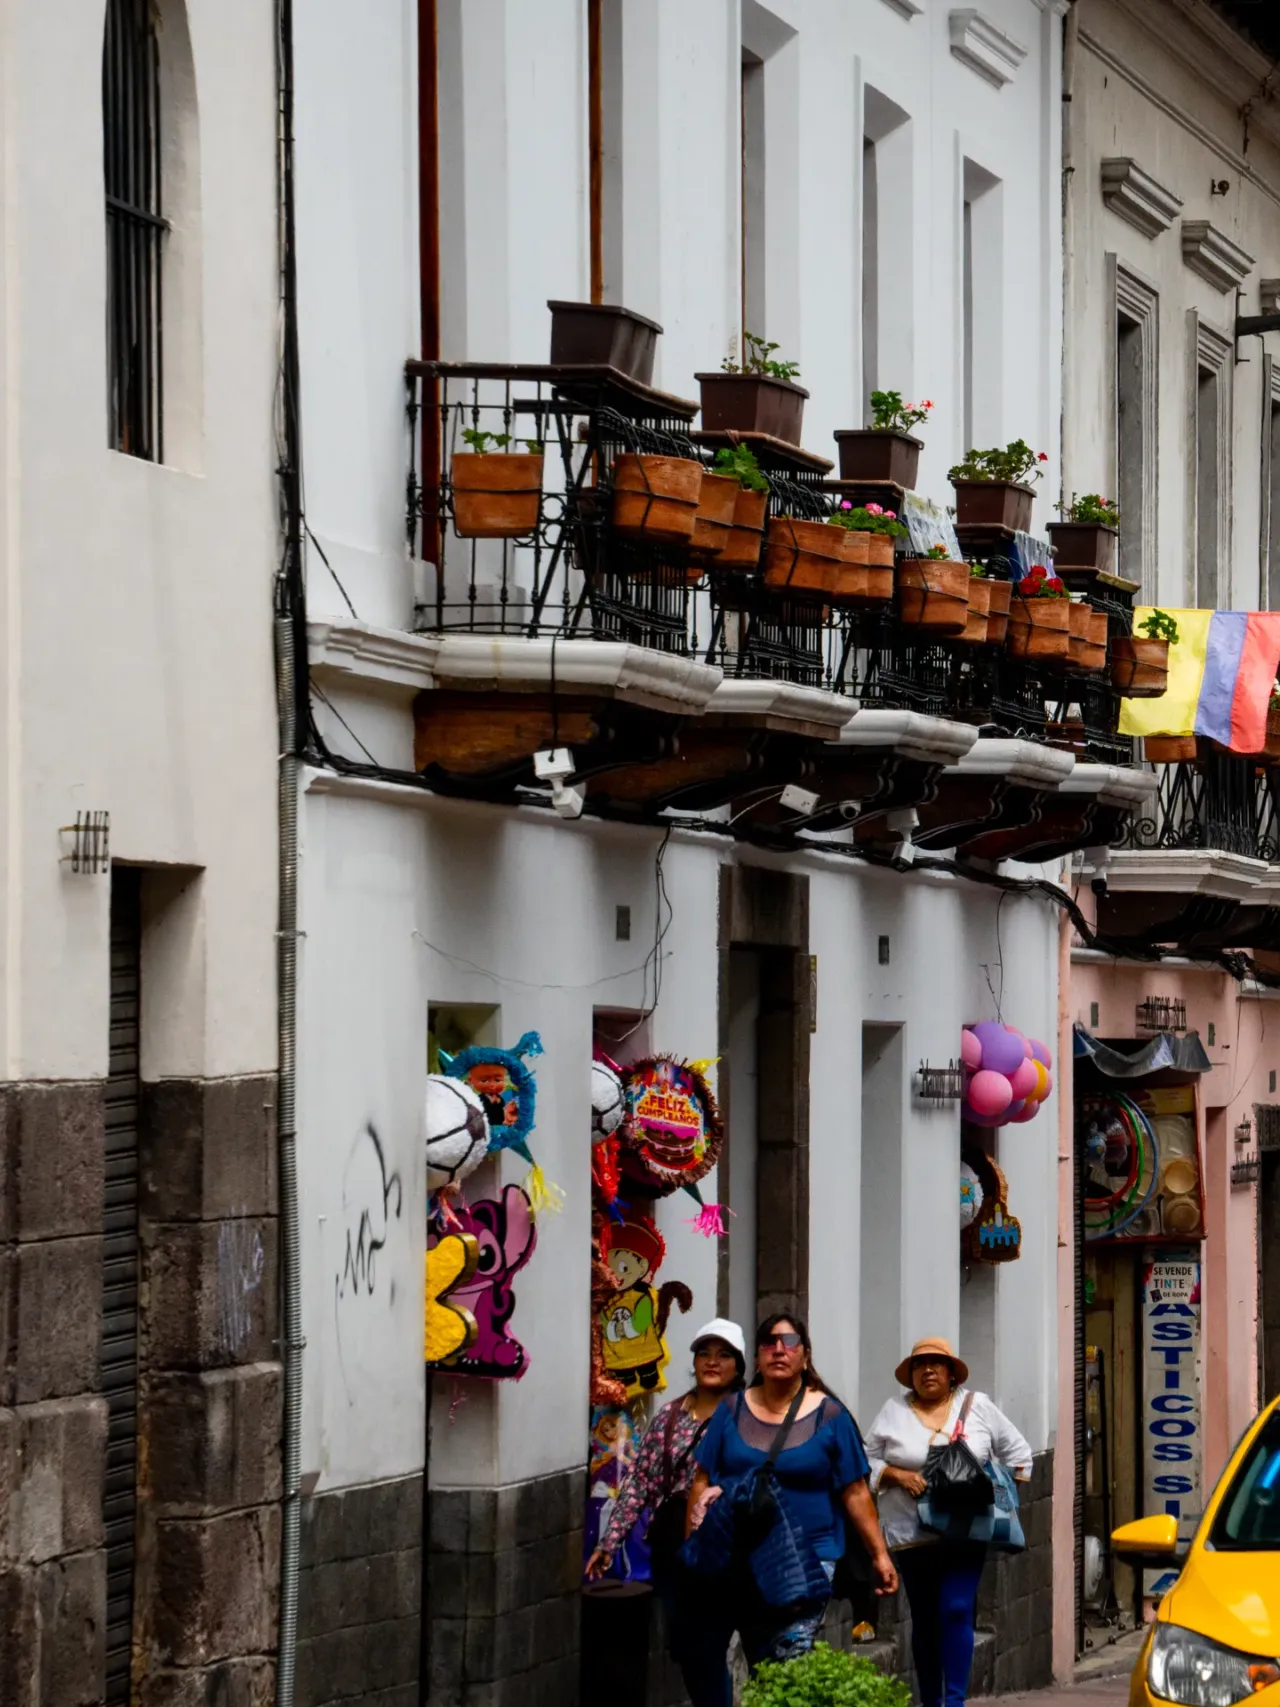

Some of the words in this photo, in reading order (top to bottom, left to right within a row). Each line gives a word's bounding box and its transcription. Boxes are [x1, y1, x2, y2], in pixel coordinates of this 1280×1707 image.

[649, 1094, 686, 1113] FELIZ
[637, 1106, 699, 1126] CUMPLEAÑOS
[1153, 1266, 1163, 1276] SE
[1165, 1266, 1192, 1276] VENDE
[1149, 1304, 1196, 1462] ASTICOS
